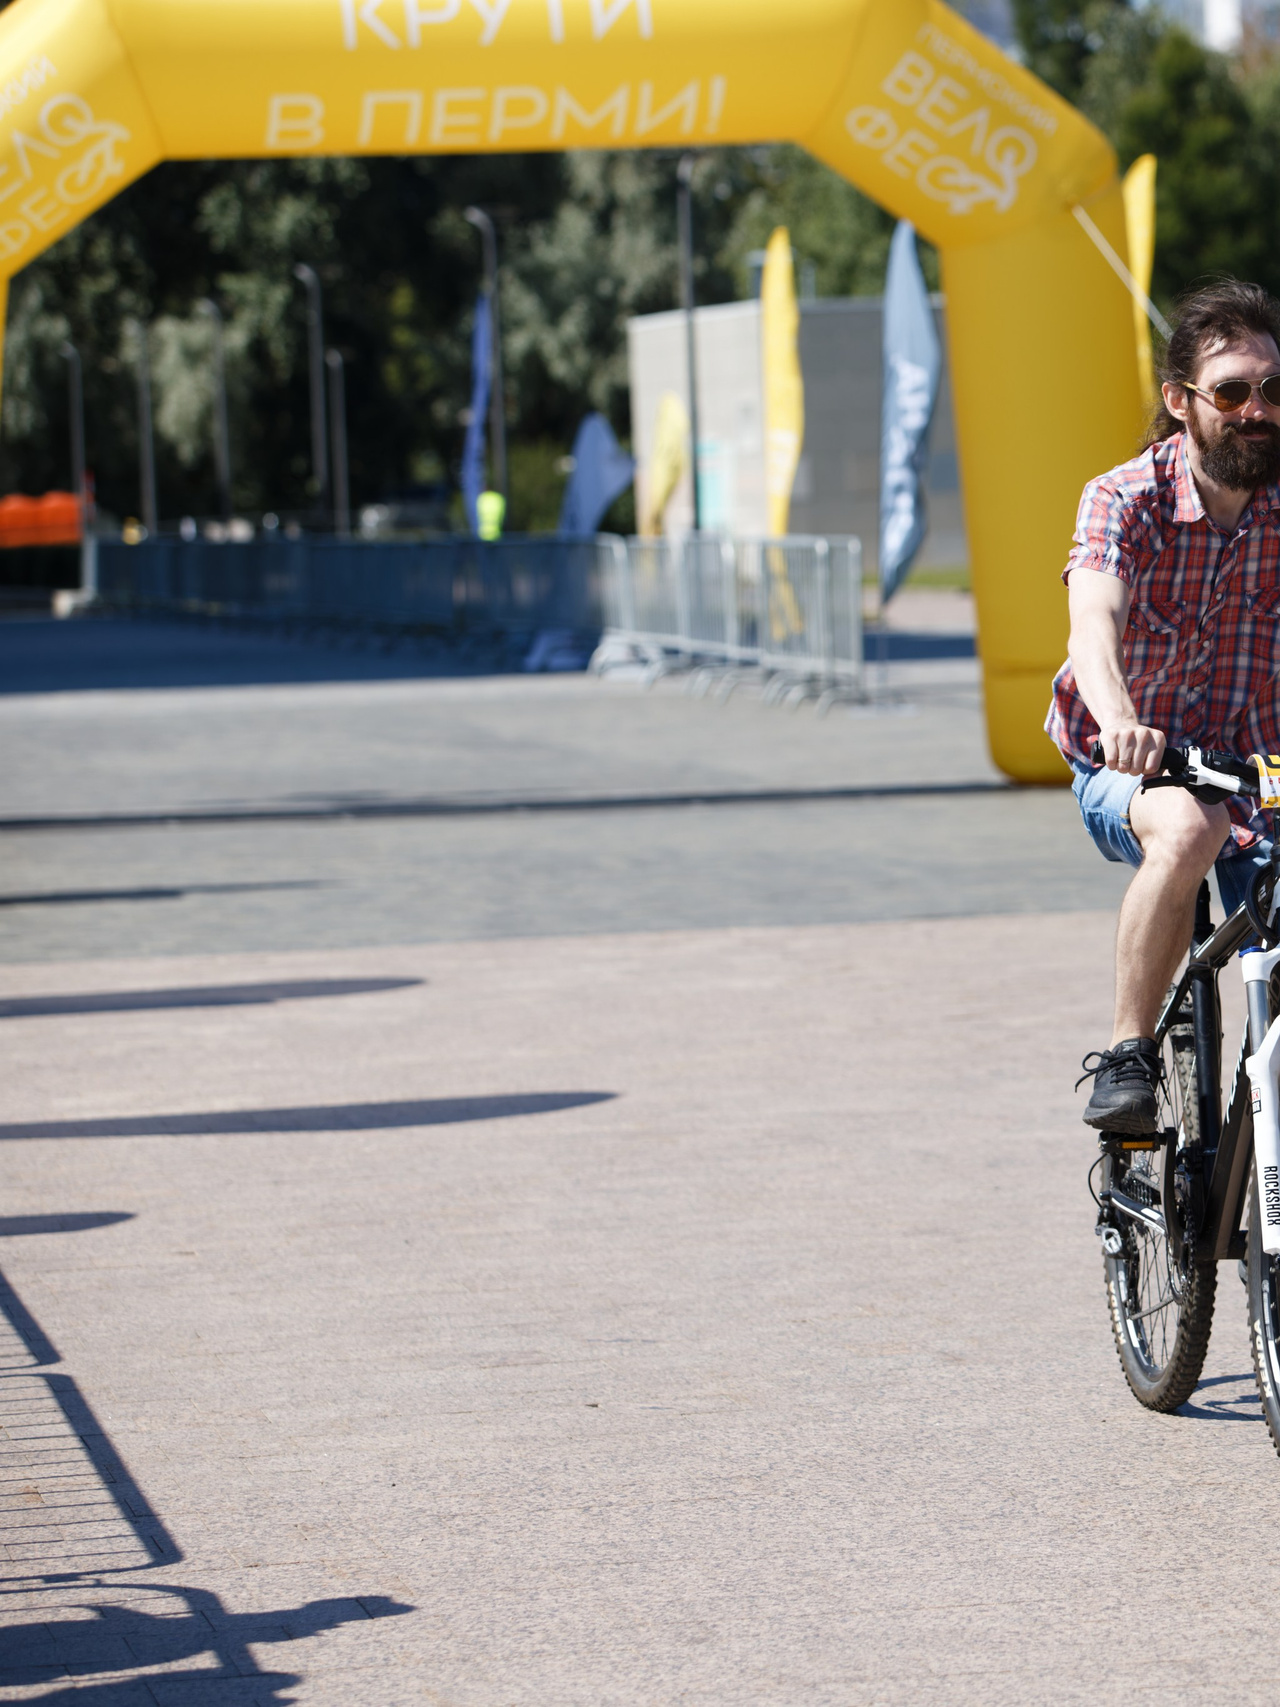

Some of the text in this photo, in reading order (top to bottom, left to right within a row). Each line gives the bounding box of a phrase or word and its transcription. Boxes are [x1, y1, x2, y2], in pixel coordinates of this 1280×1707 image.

[265, 75, 727, 149] В ПЕРМИ!
[1253, 1318, 1274, 1398] KENDA
